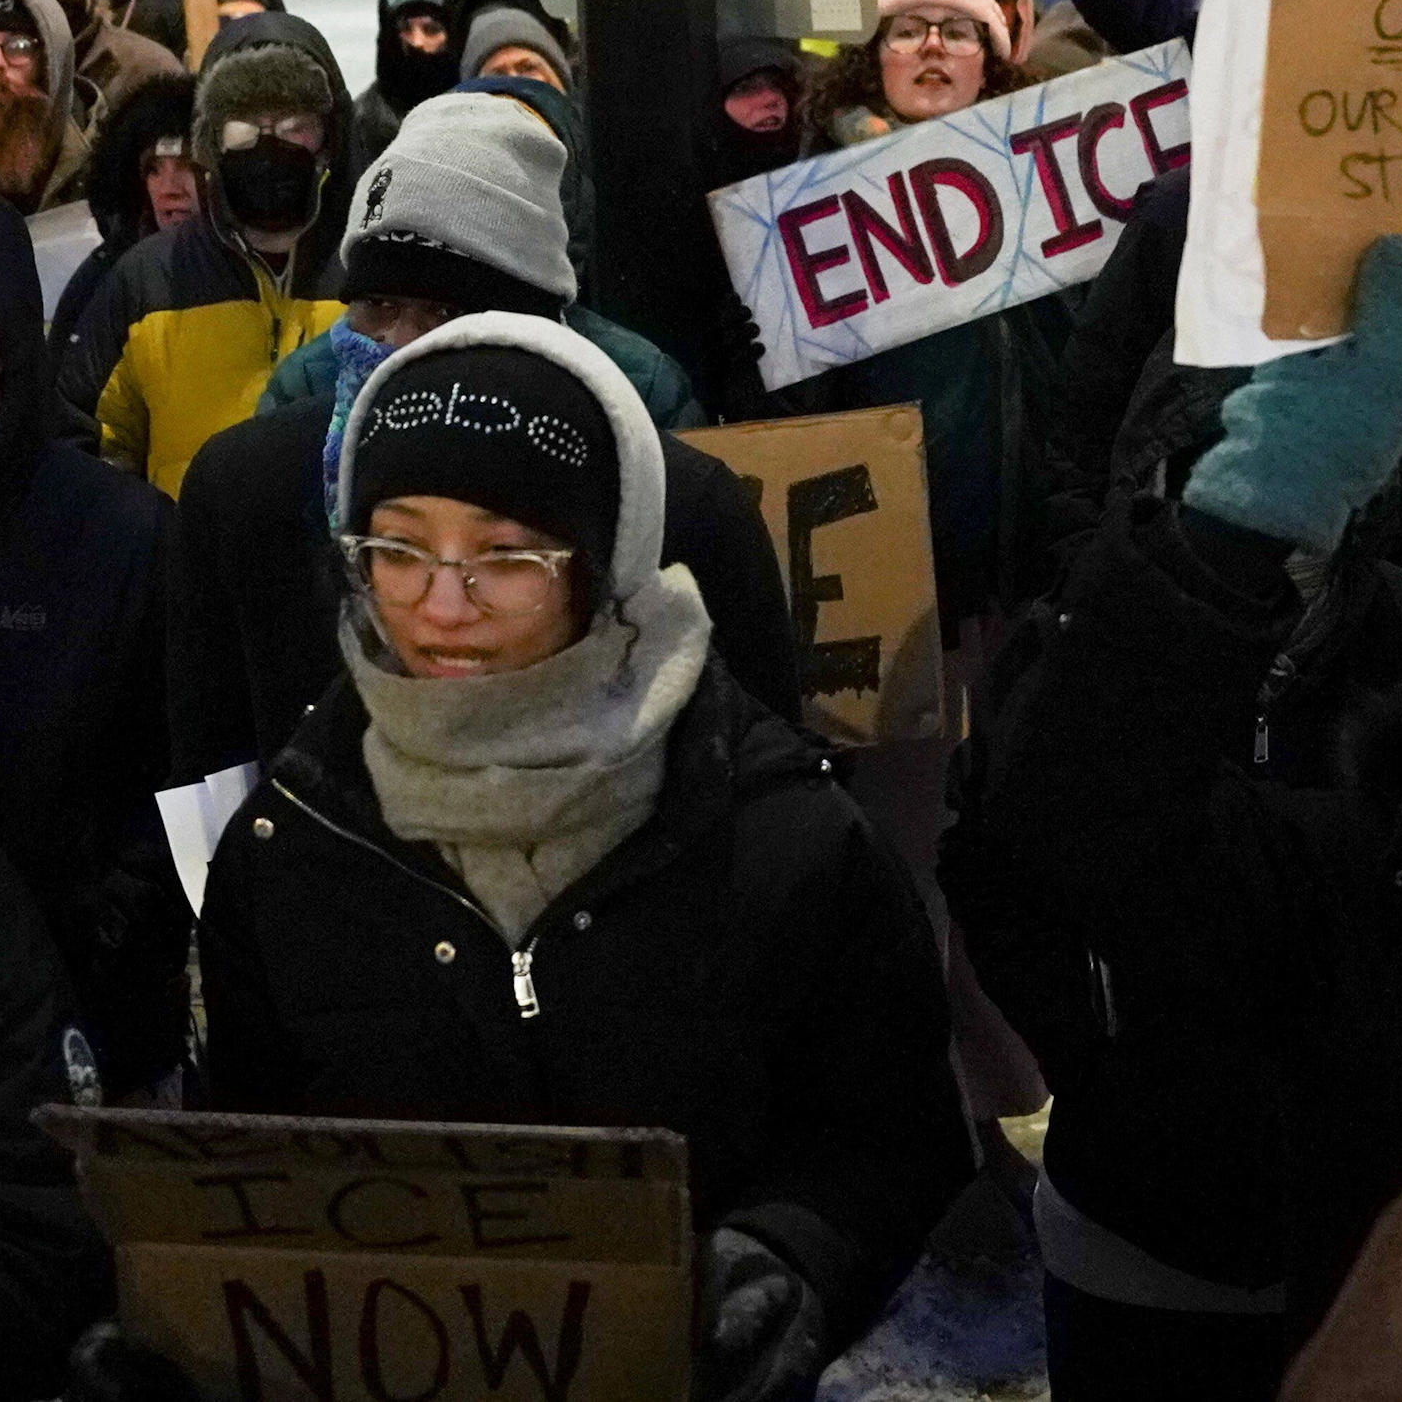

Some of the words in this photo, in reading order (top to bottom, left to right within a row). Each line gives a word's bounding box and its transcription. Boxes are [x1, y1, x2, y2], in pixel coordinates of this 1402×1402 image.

[776, 157, 1005, 330] END
[1010, 78, 1192, 259] ICE
[195, 1171, 572, 1249] ICE
[222, 1270, 592, 1402] NOW
